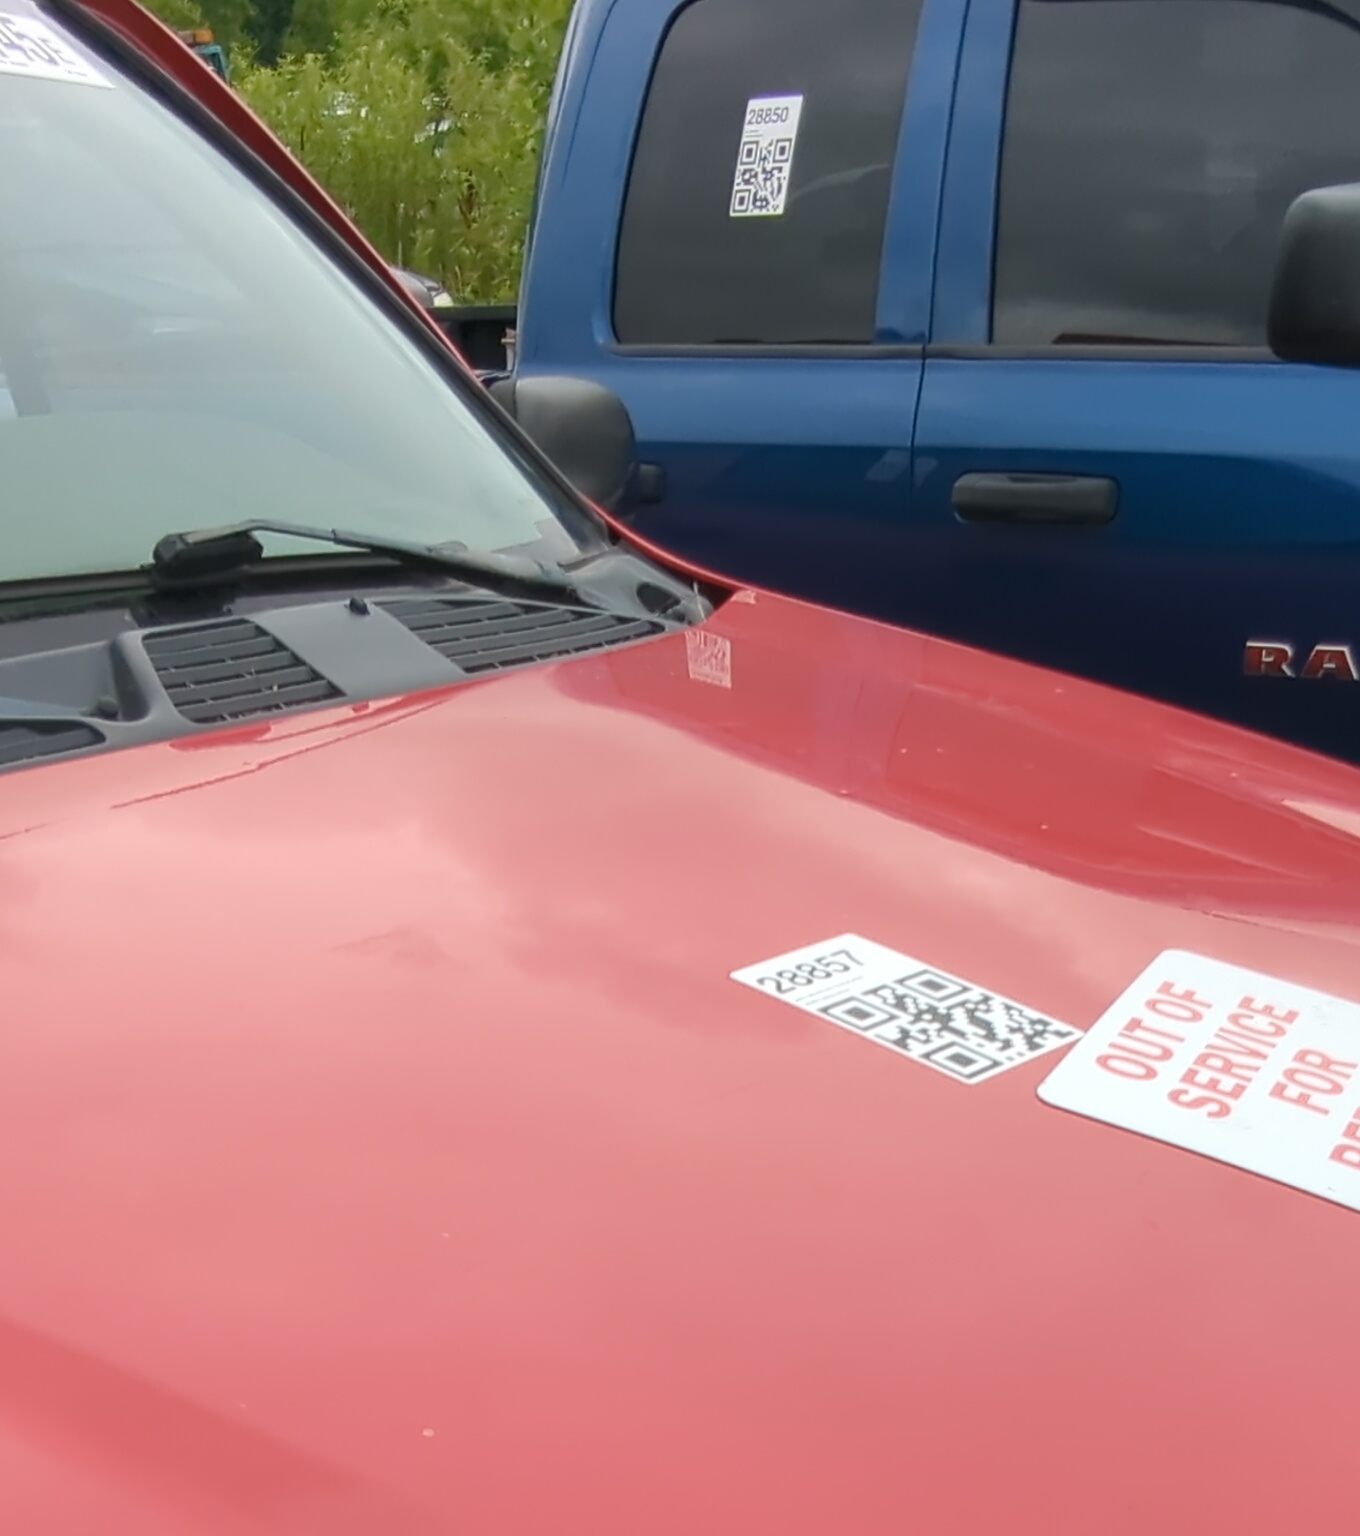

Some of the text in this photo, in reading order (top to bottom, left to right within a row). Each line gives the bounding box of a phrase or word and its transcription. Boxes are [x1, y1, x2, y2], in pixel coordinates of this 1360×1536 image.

[746, 106, 789, 125] 28850
[756, 949, 865, 994] 28857
[1094, 981, 1214, 1082] OUT OF
[1166, 996, 1301, 1119] SERVICE
[1268, 1048, 1359, 1116] FOR
